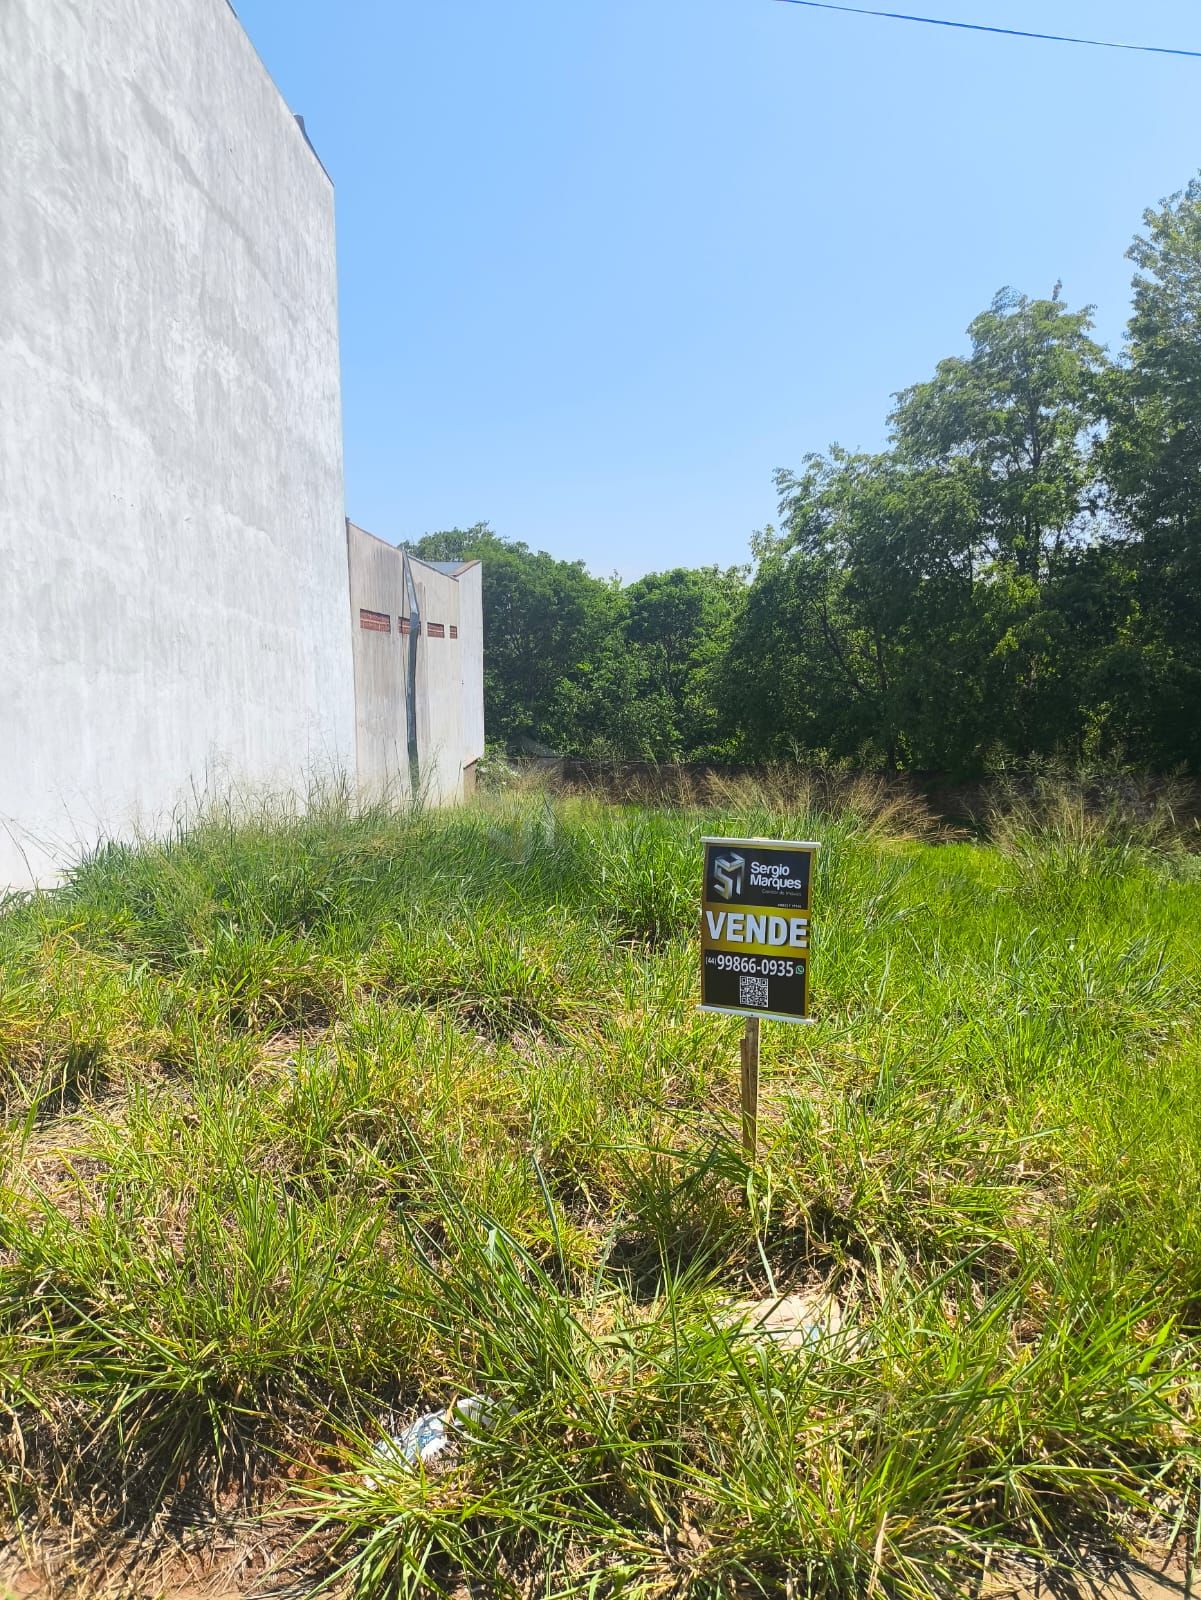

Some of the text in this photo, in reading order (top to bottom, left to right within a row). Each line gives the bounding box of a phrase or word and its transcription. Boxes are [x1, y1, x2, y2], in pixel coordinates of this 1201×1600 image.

[750, 861, 790, 879] Sergio
[750, 873, 802, 890] Marques
[705, 911, 808, 948] VENDE
[717, 954, 794, 977] 99866-0935
